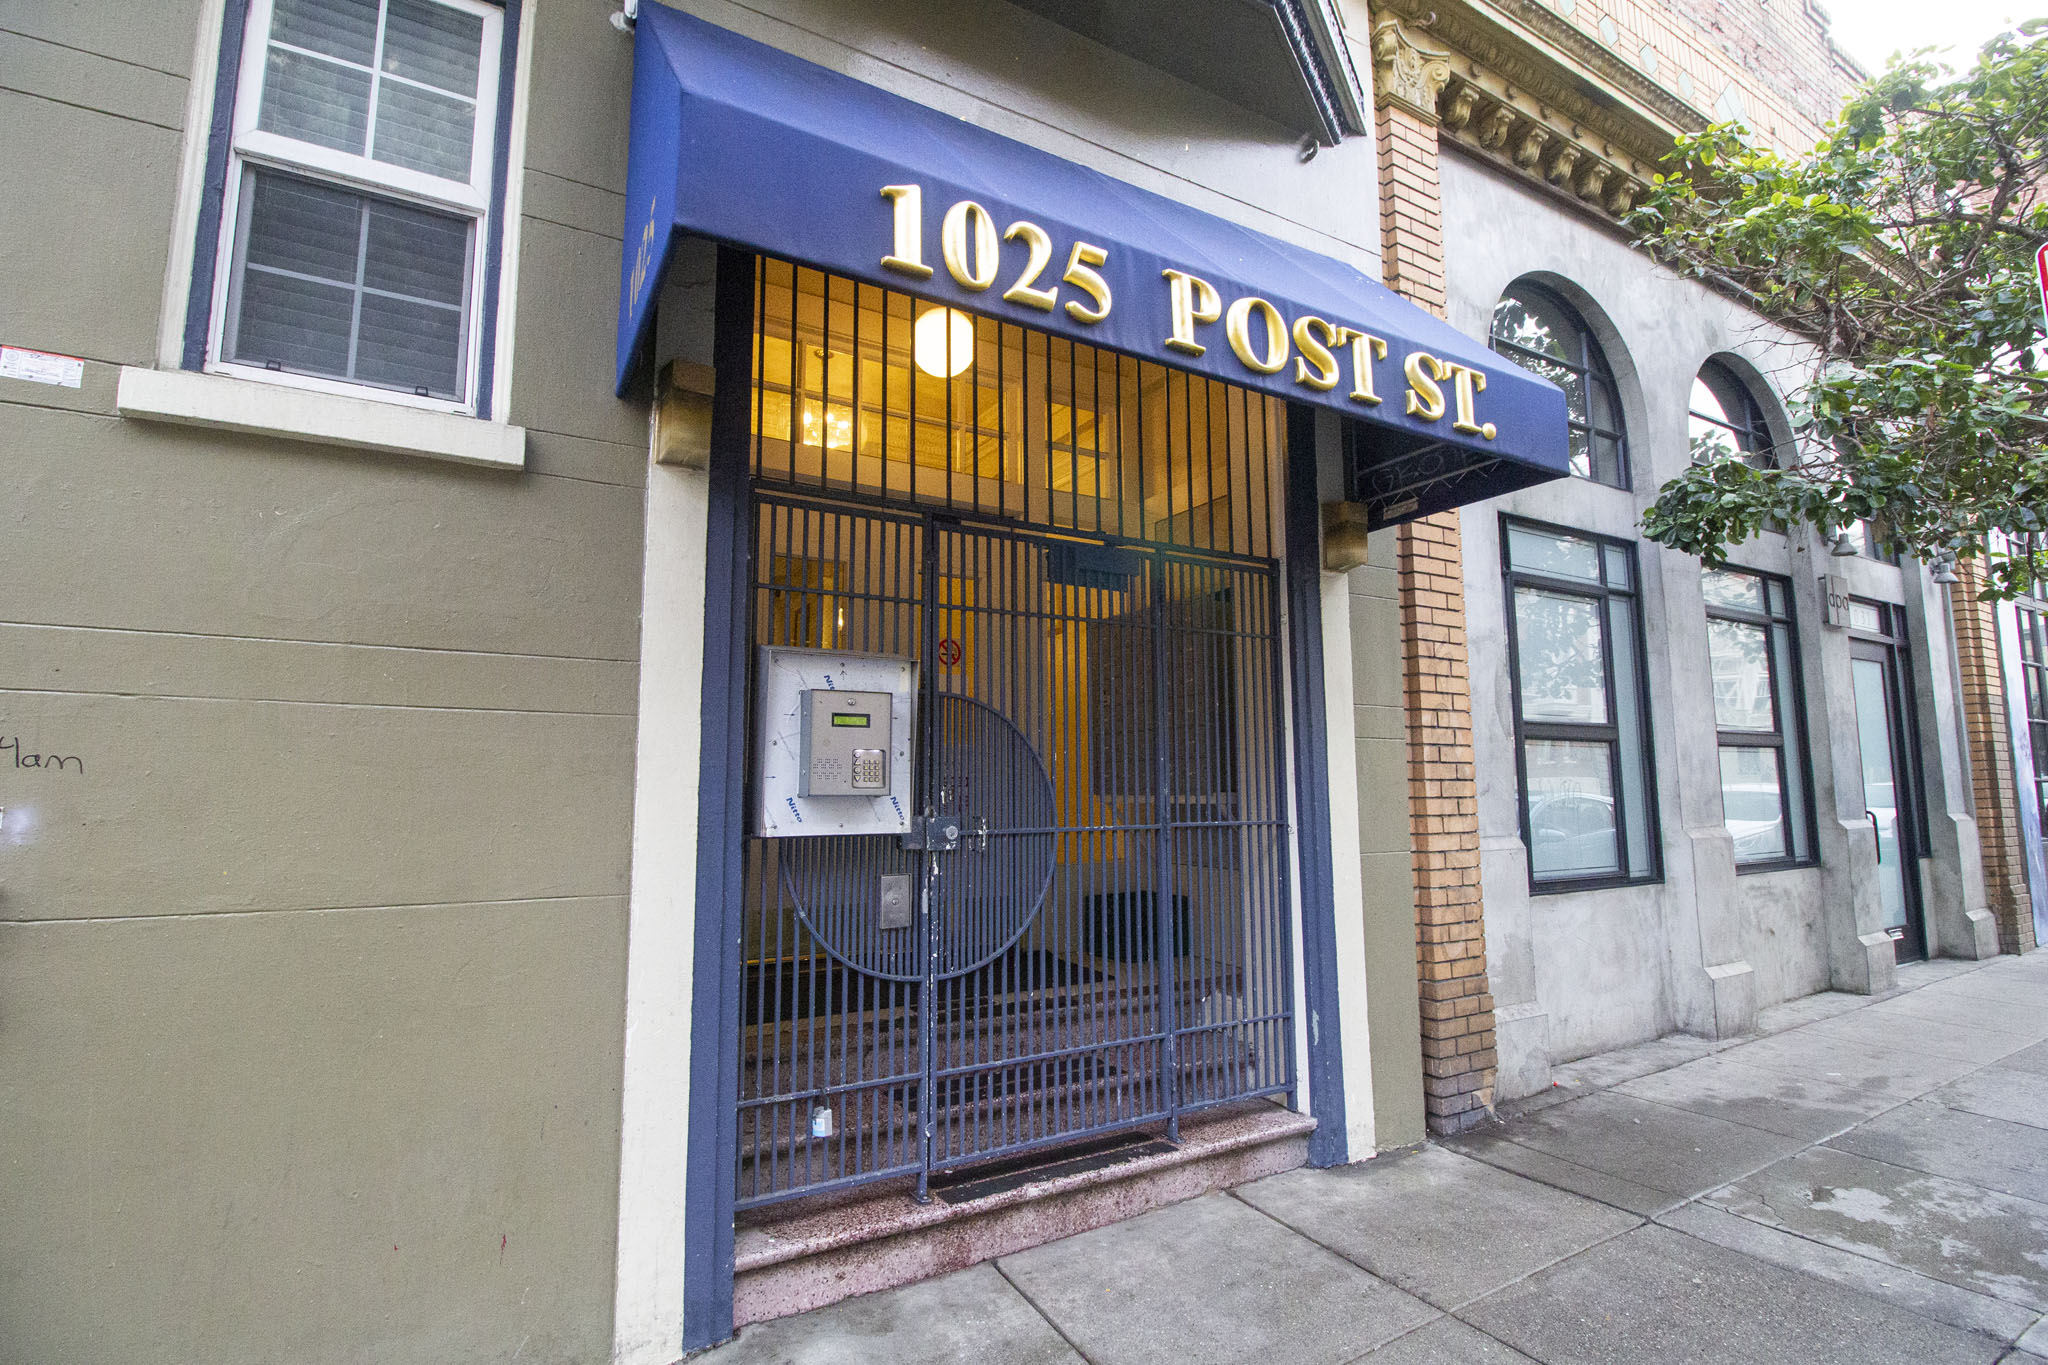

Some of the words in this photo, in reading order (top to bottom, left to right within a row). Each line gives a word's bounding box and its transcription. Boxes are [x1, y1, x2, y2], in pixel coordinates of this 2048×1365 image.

[881, 184, 1113, 324] 1025
[1162, 268, 1388, 405] POST
[1403, 351, 1498, 441] ST.
[786, 797, 802, 823] Nitto
[890, 796, 905, 821] Nitto
